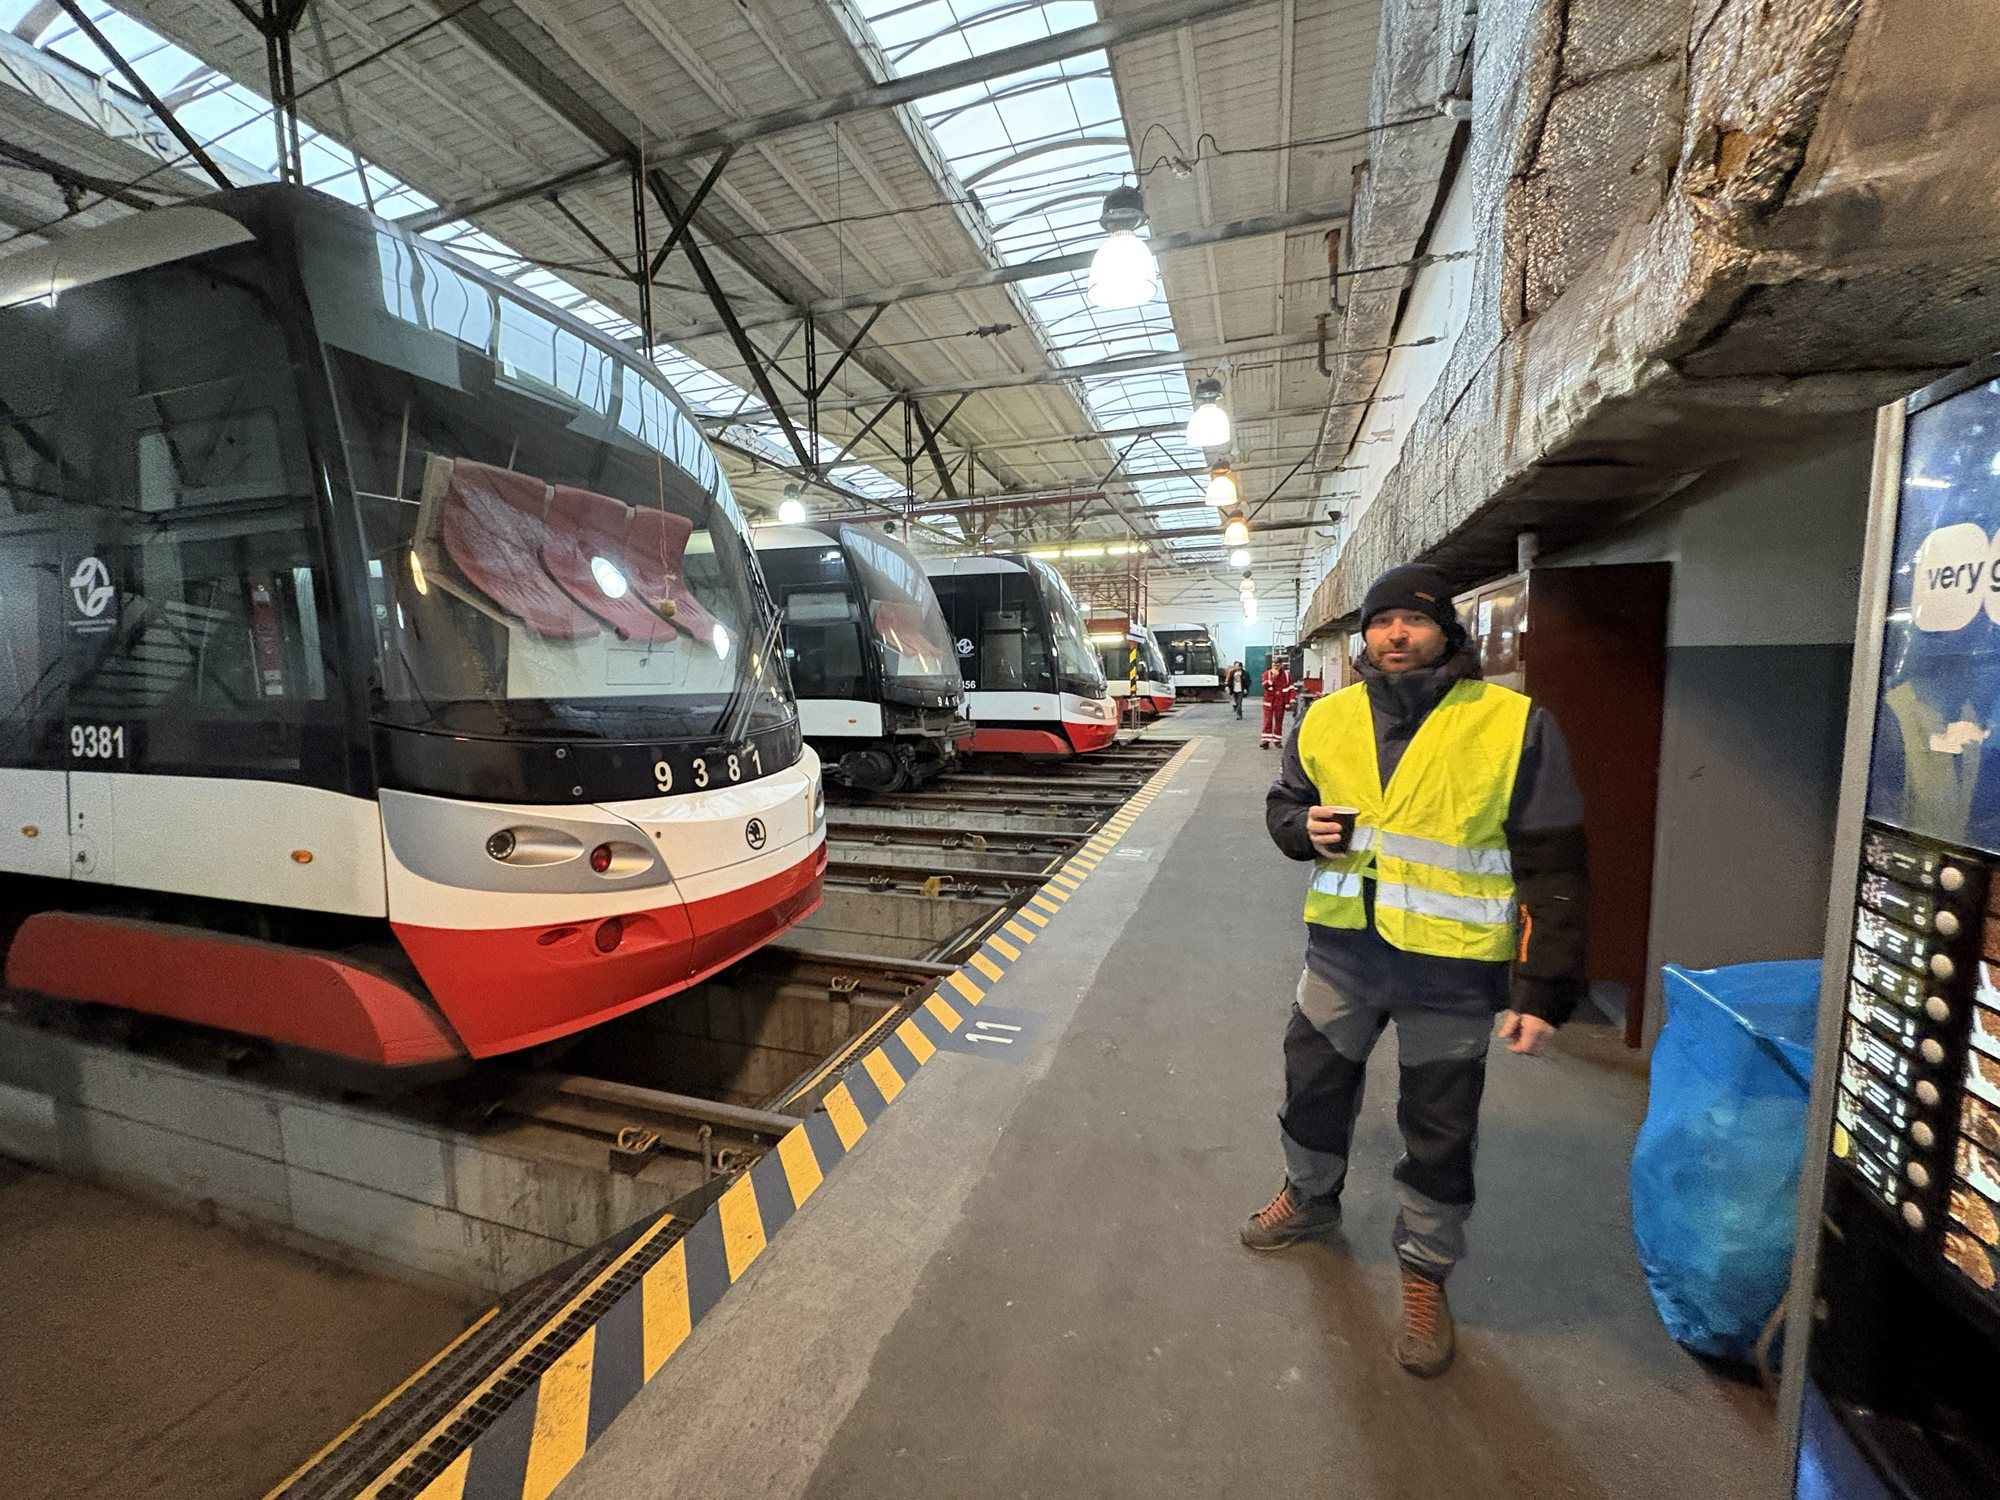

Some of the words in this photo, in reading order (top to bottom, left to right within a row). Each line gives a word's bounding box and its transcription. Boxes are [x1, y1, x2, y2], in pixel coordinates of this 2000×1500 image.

[1928, 561, 1985, 594] very
[70, 725, 125, 759] 9381
[654, 749, 763, 792] 9381
[965, 1021, 1022, 1044] 11
